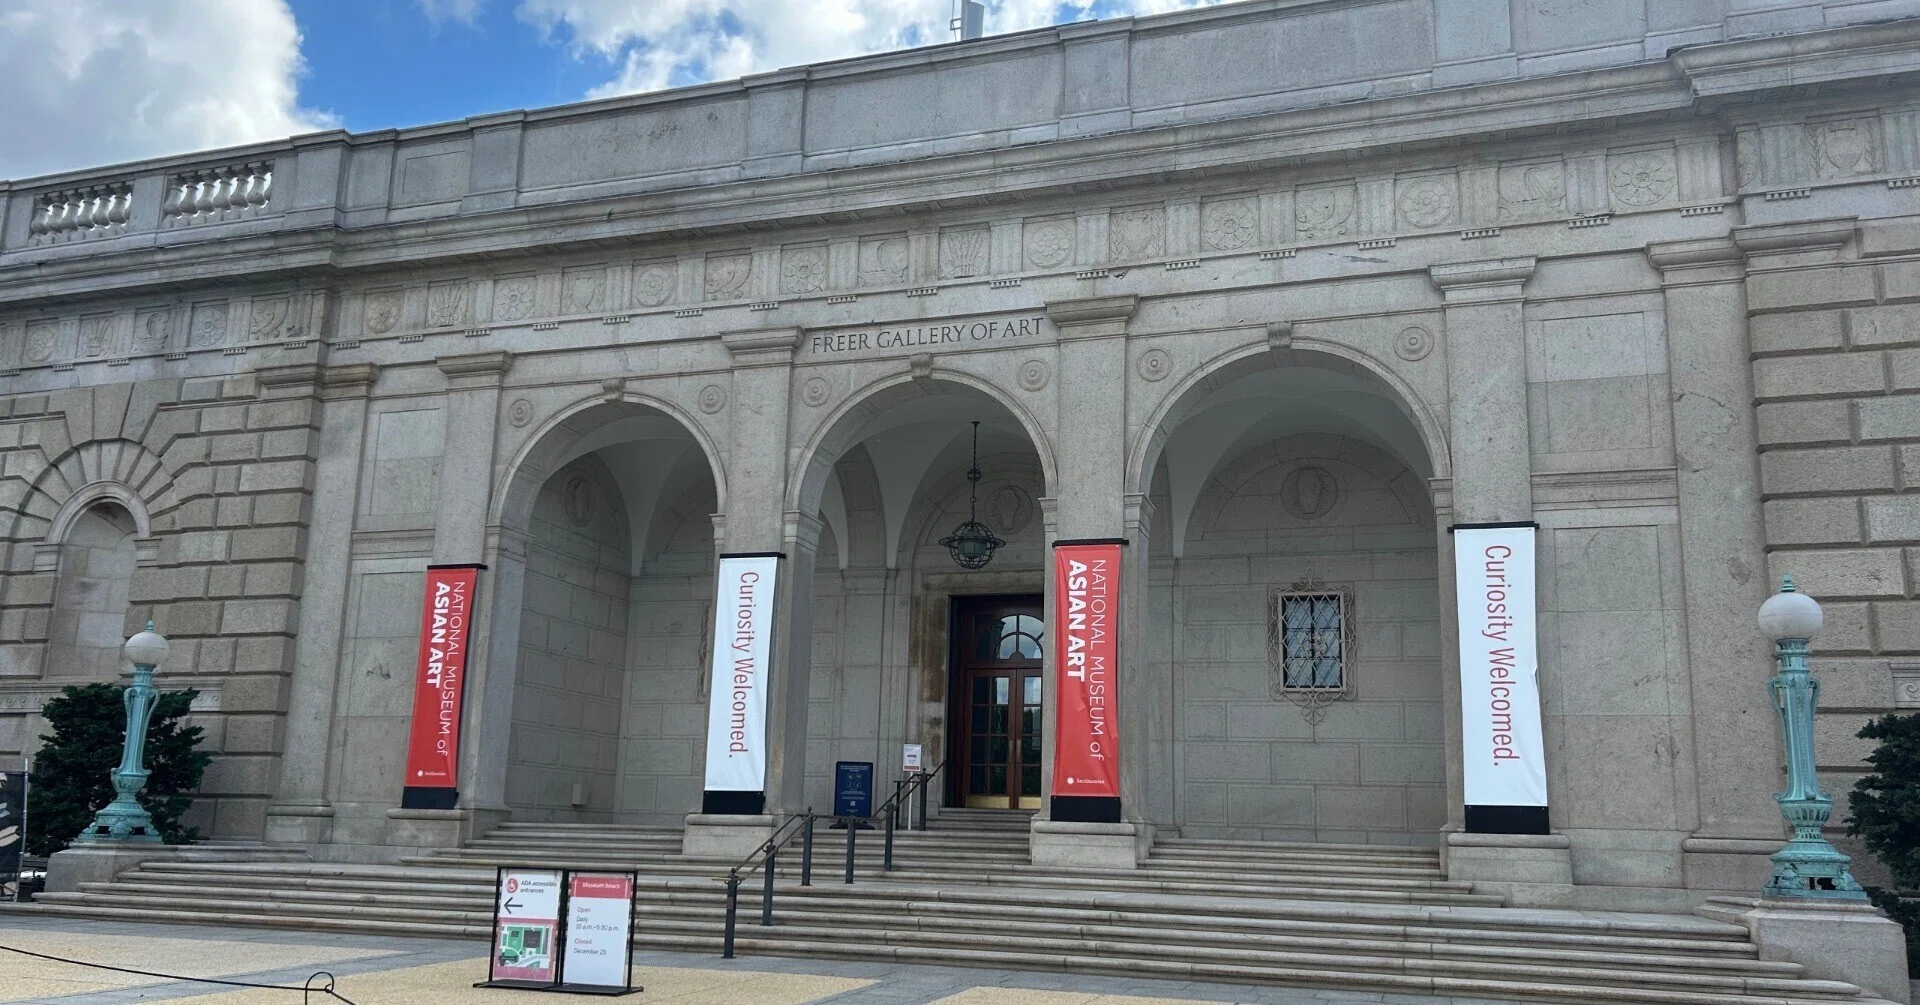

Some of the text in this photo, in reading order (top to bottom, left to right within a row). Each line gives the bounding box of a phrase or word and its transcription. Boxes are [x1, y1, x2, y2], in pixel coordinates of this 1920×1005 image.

[812, 317, 1044, 354] FREER GALLERY OF ART
[426, 581, 450, 688] ASIAN ART
[437, 581, 466, 757] NATIONAL MUSEUM of
[729, 571, 759, 758] Curiosity Welcomed.
[1067, 559, 1087, 682] ASIAN ART
[1089, 559, 1106, 761] NATIONAL MUSEUM of
[1481, 545, 1520, 766] Curiosity Welcomed.
